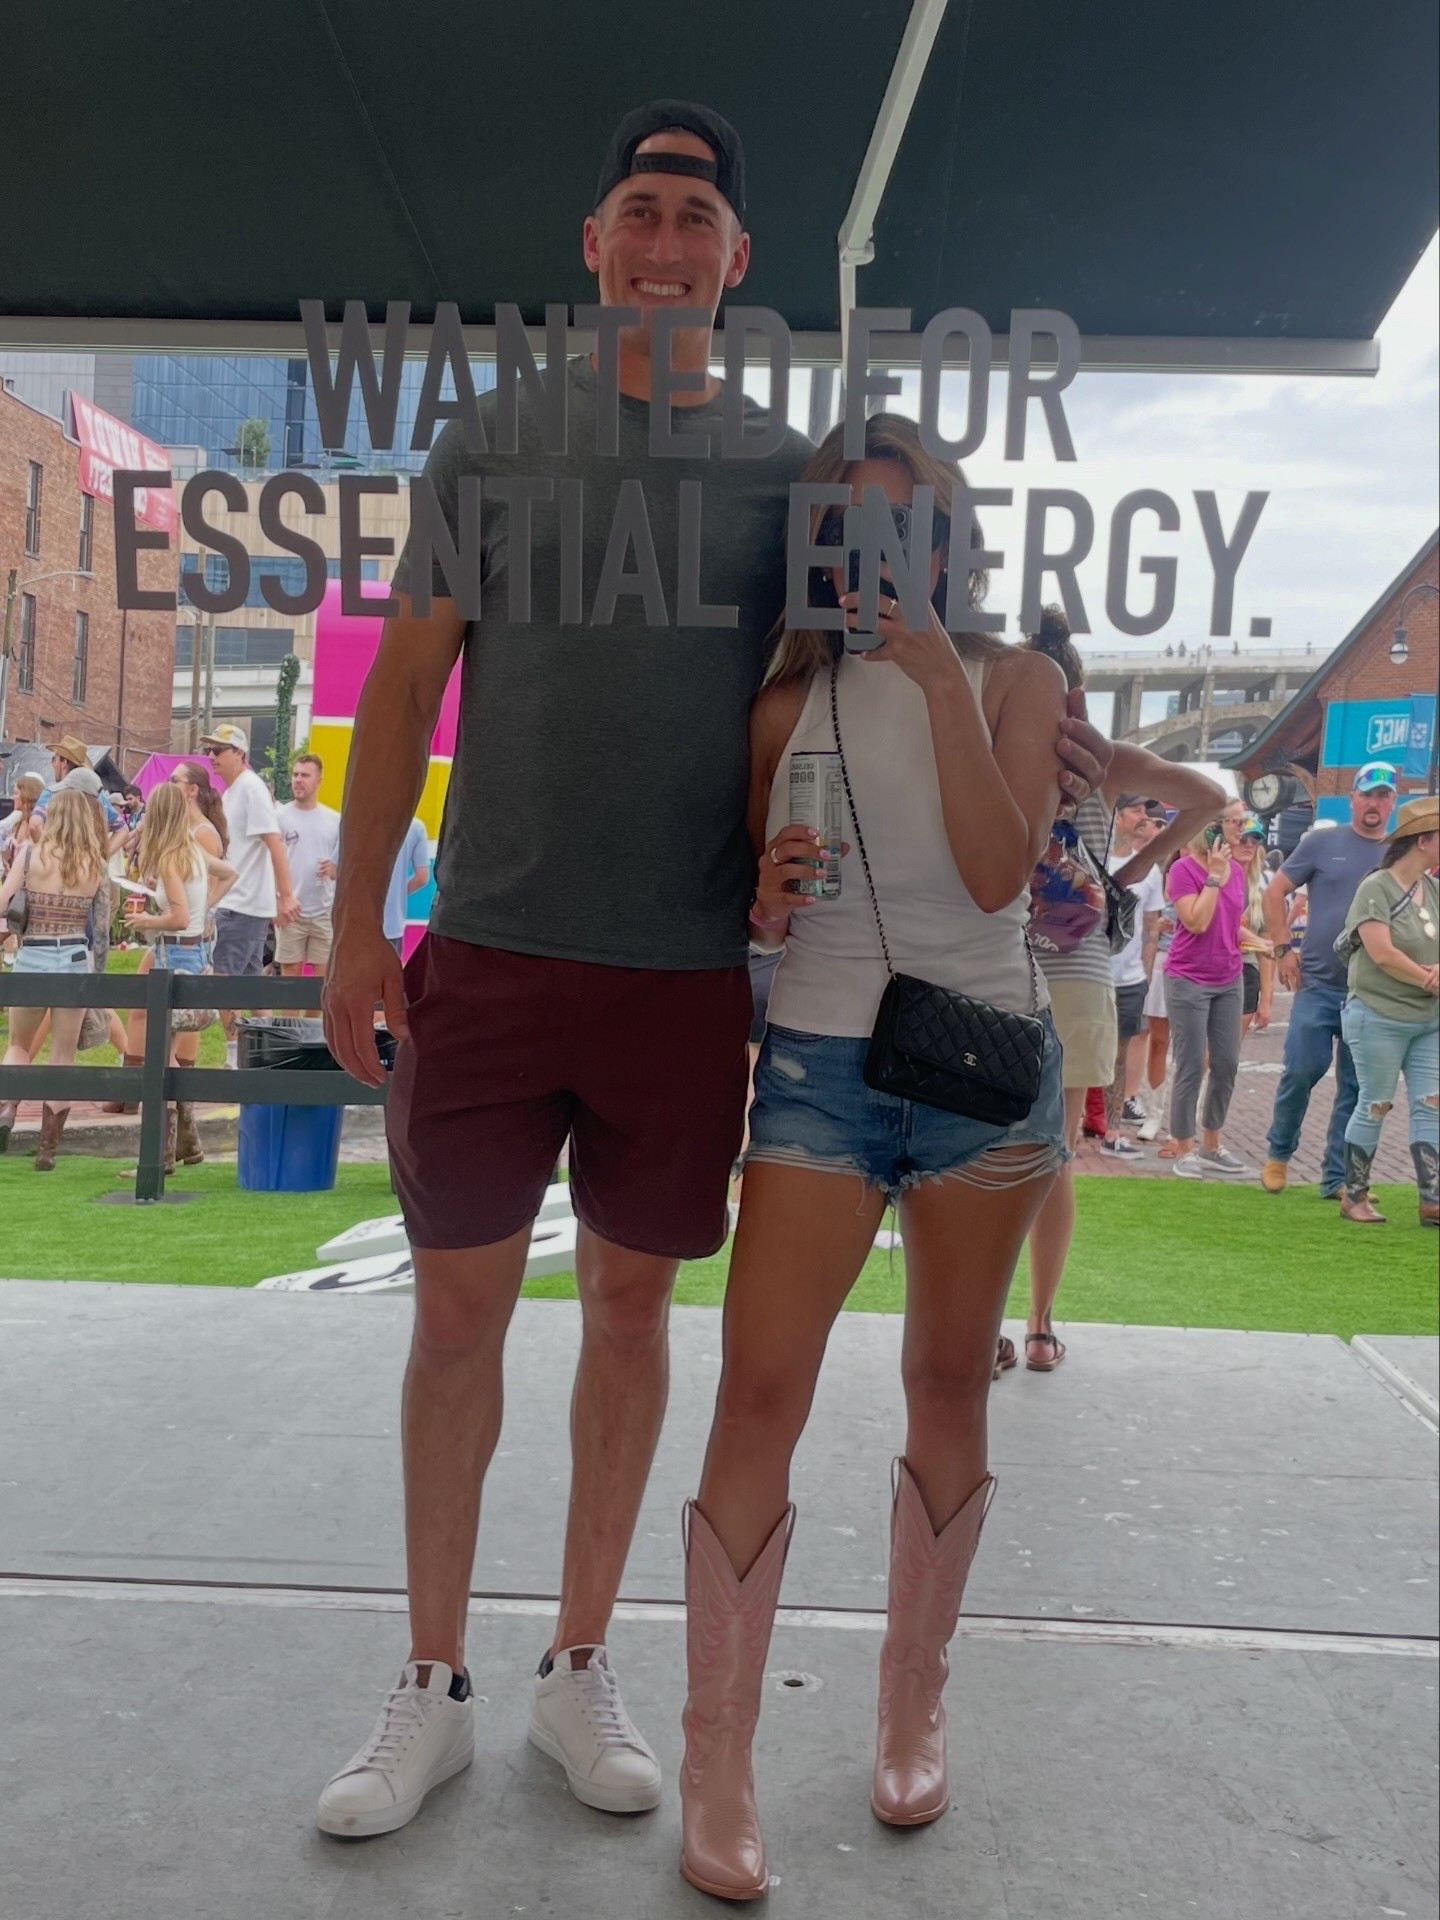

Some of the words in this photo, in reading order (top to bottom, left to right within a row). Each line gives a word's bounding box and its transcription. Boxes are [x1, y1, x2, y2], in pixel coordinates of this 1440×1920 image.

[298, 299, 792, 460] WANTED
[842, 307, 1082, 462] FOR
[113, 469, 740, 628] ESSENTIAL
[785, 482, 1272, 639] ENERGY.
